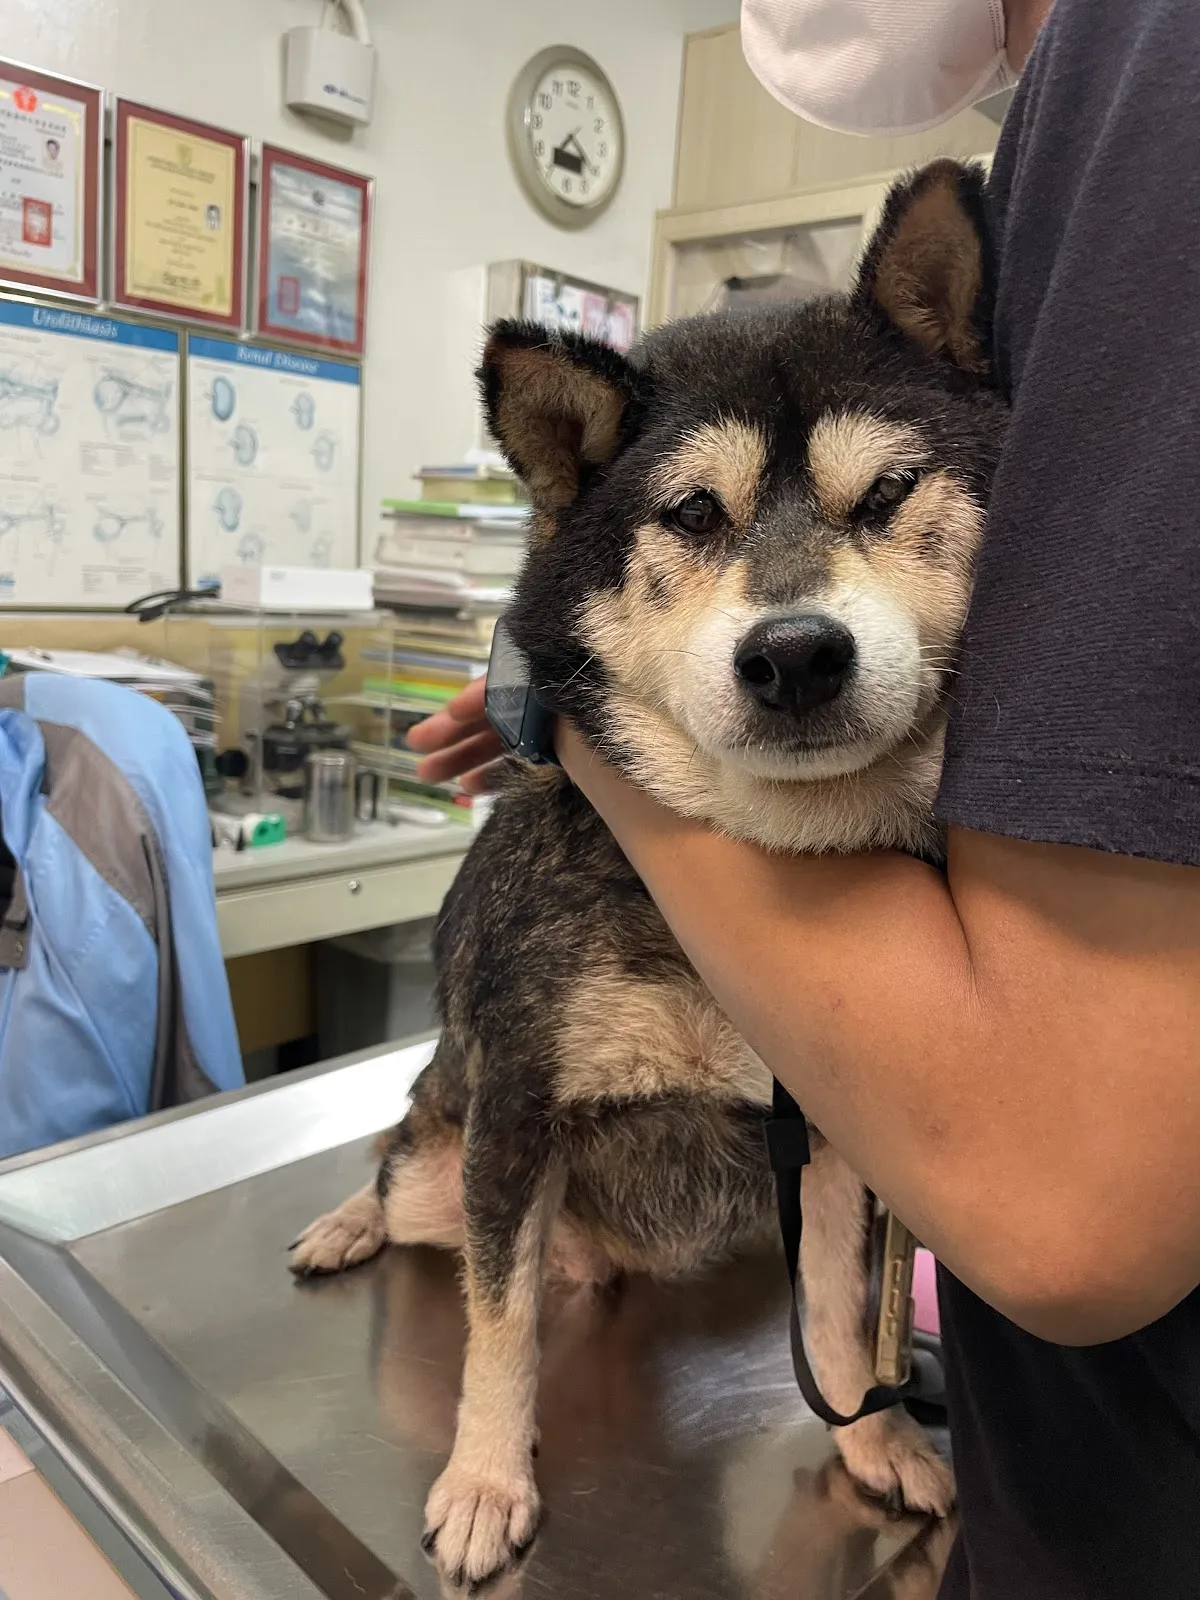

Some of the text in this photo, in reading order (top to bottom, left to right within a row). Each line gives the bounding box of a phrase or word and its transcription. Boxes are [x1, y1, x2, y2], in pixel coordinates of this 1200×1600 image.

[566, 80, 581, 98] 12
[539, 93, 553, 111] 10
[593, 118, 605, 134] 2
[32, 306, 119, 339] Urolithiasis
